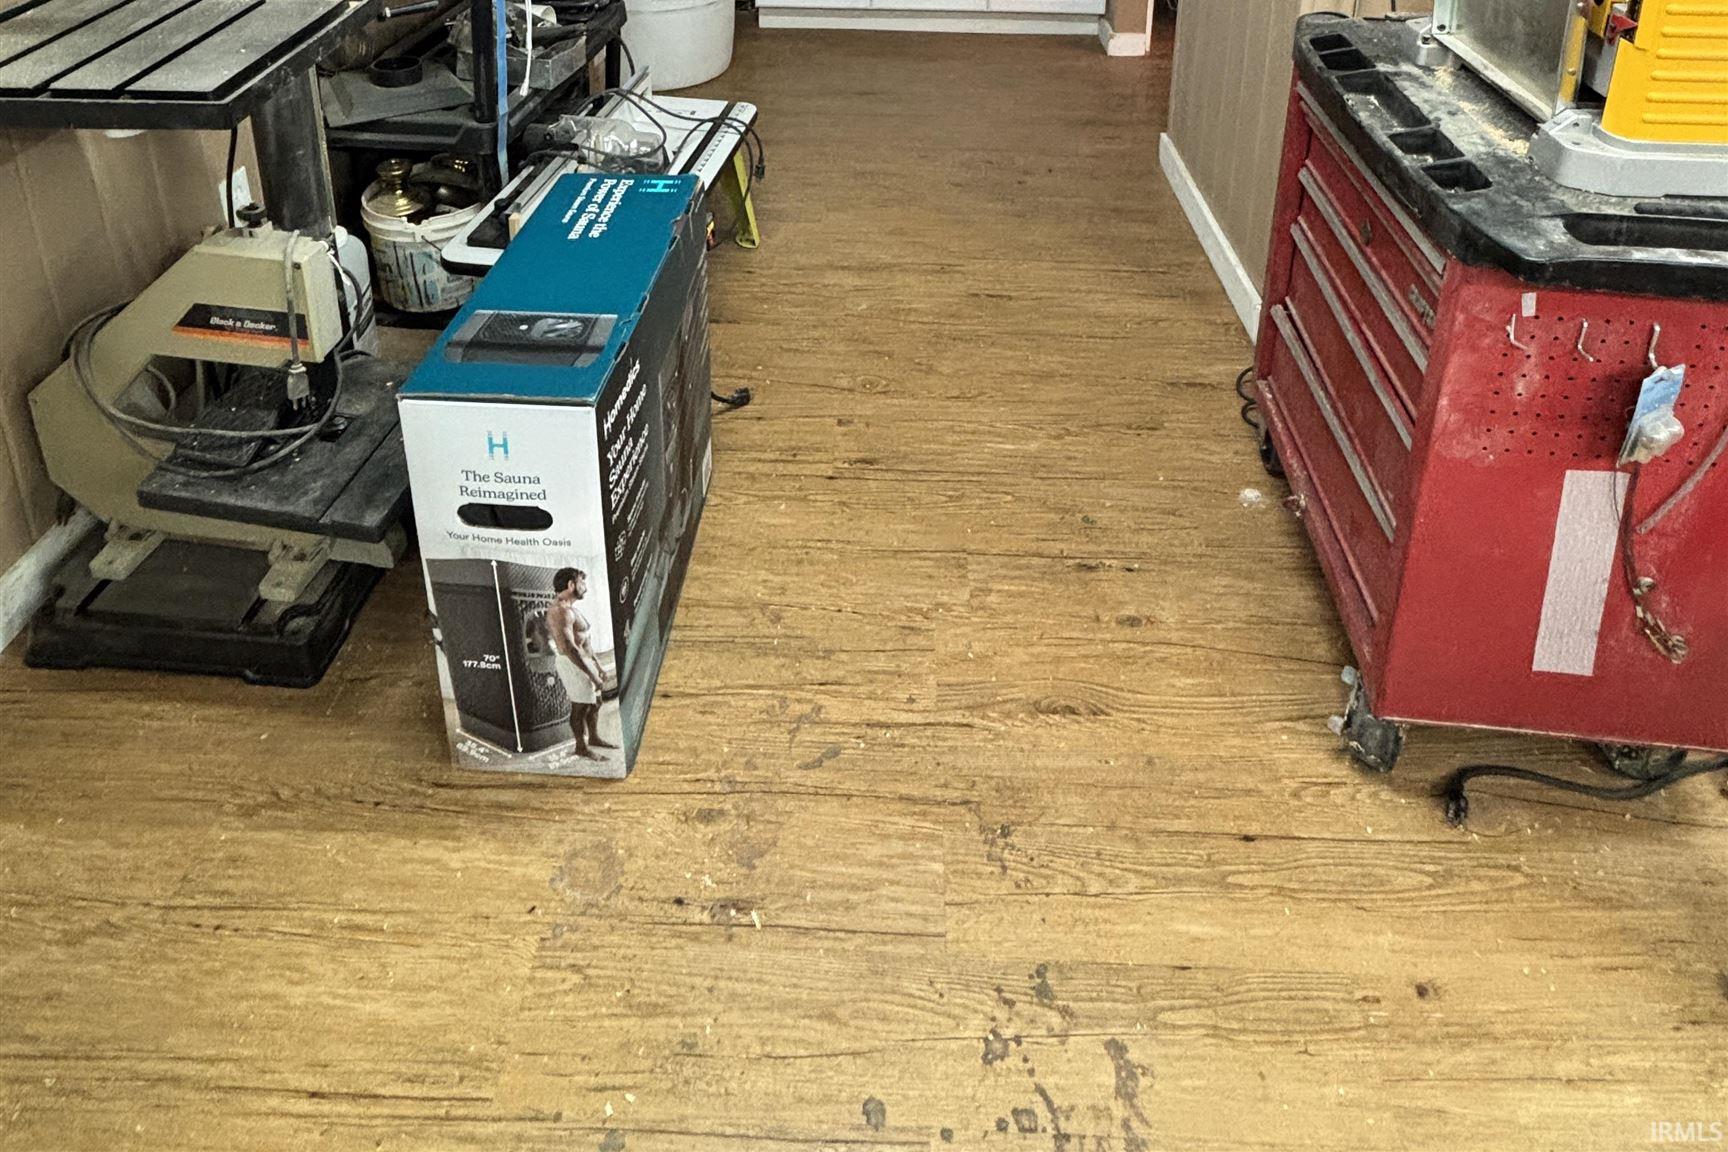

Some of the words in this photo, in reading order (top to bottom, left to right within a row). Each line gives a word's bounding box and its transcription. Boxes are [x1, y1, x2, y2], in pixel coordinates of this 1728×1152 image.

[591, 178, 618, 204] Power
[597, 178, 635, 224] Experience
[585, 202, 600, 214] of
[566, 212, 597, 240] Sauna
[588, 222, 608, 239] the
[209, 316, 235, 327] Black
[243, 319, 277, 331] Decker
[602, 356, 641, 441] Homedics
[606, 425, 627, 467] Your
[626, 383, 647, 432] Home
[486, 430, 510, 461] H
[608, 436, 633, 490] Sauna
[610, 422, 649, 511] Experience
[460, 469, 491, 483] The
[493, 471, 541, 485] Sauna
[459, 485, 547, 502] Reimagined
[446, 530, 469, 541] Your
[472, 533, 503, 545] Home
[505, 536, 540, 547] Health
[542, 537, 572, 548] Oasis
[462, 660, 501, 670] 177.8cm
